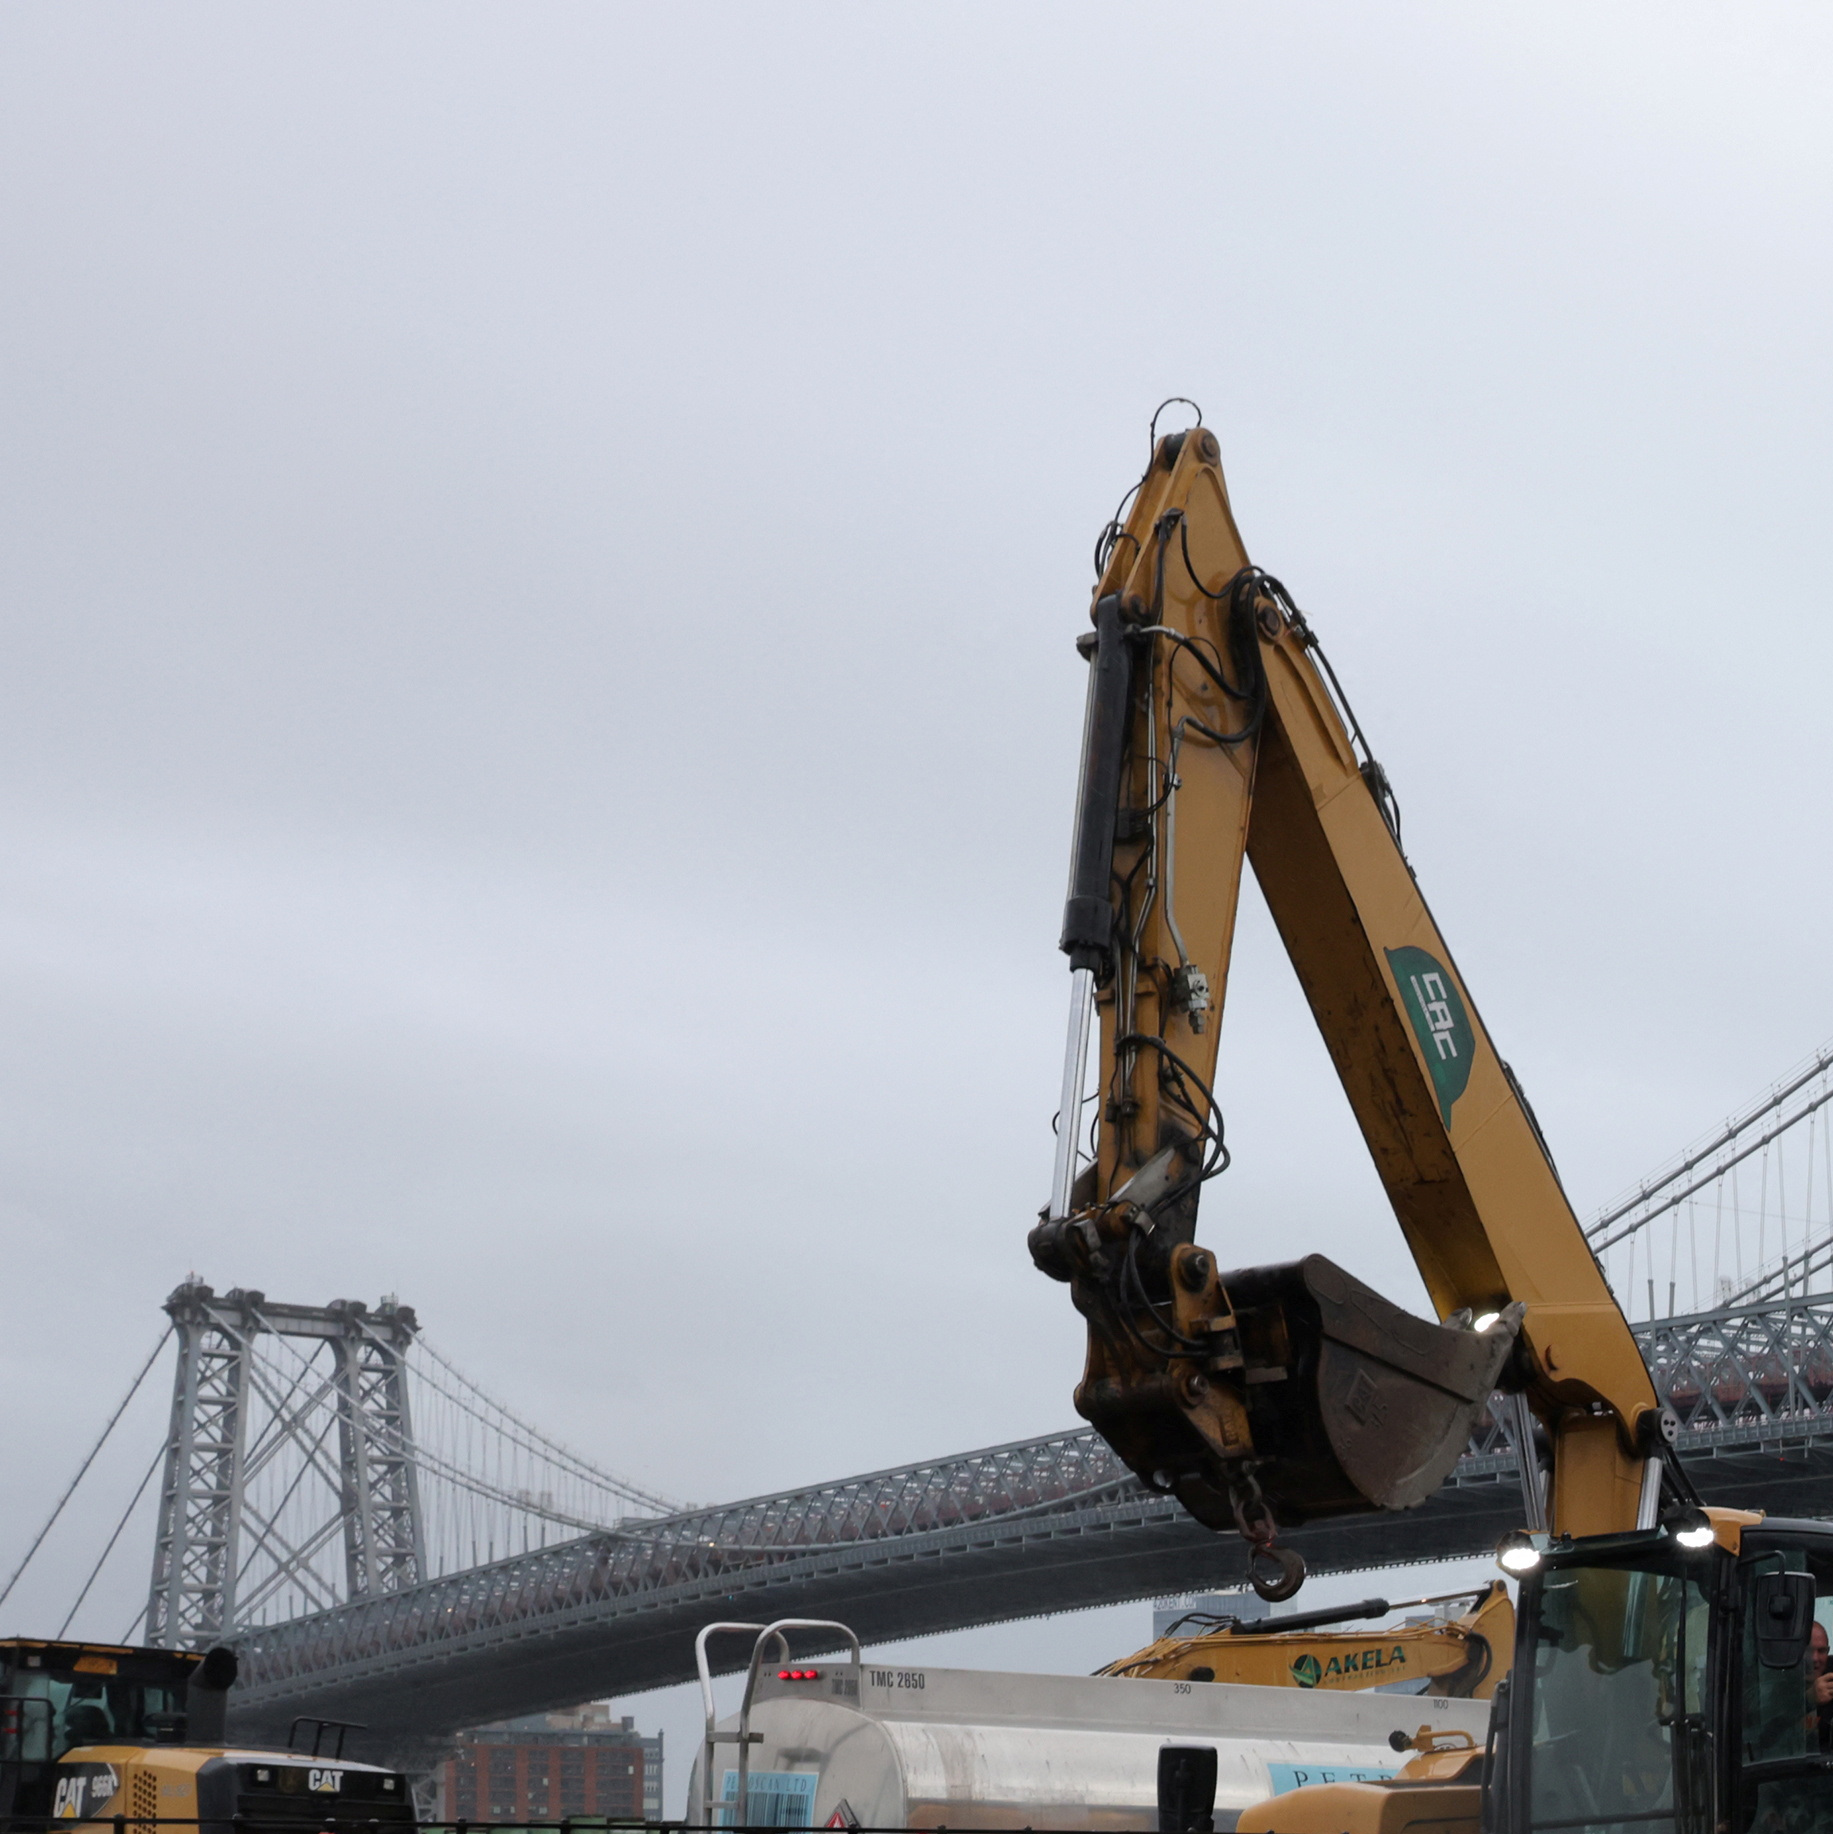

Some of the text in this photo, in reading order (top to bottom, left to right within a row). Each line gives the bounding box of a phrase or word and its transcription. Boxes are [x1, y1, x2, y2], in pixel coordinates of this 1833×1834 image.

[1422, 971, 1458, 1061] CAC
[1324, 1645, 1406, 1678] AKELA
[870, 1670, 893, 1688] TMC
[1173, 1683, 1191, 1695] 350
[308, 1769, 343, 1793] CAT
[785, 1777, 808, 1792] LTD
[53, 1777, 87, 1818] CAT
